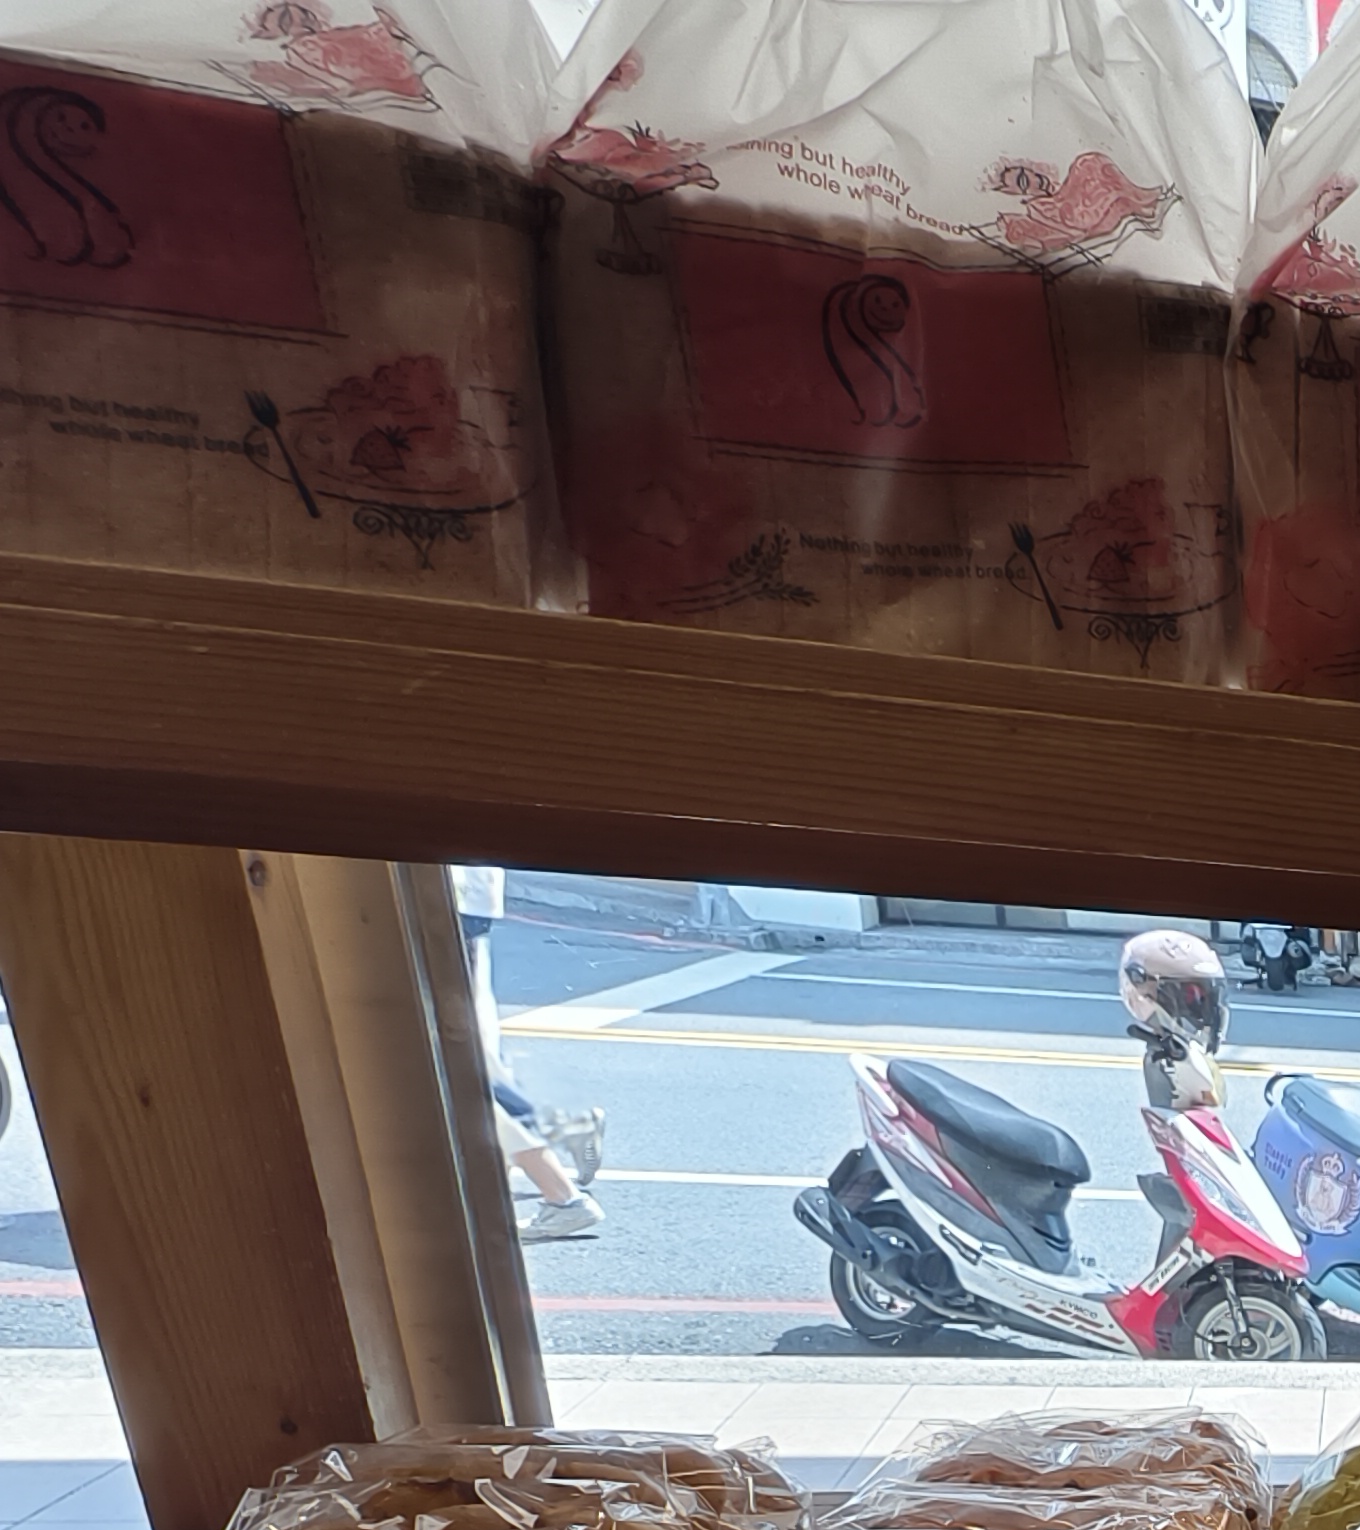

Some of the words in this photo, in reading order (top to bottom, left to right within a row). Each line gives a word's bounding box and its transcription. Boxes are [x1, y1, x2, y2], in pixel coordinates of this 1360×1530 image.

[801, 142, 835, 171] but
[842, 156, 910, 196] healthy
[777, 162, 840, 194] whole
[906, 203, 963, 236] bread
[1060, 1299, 1098, 1319] KYMCO
